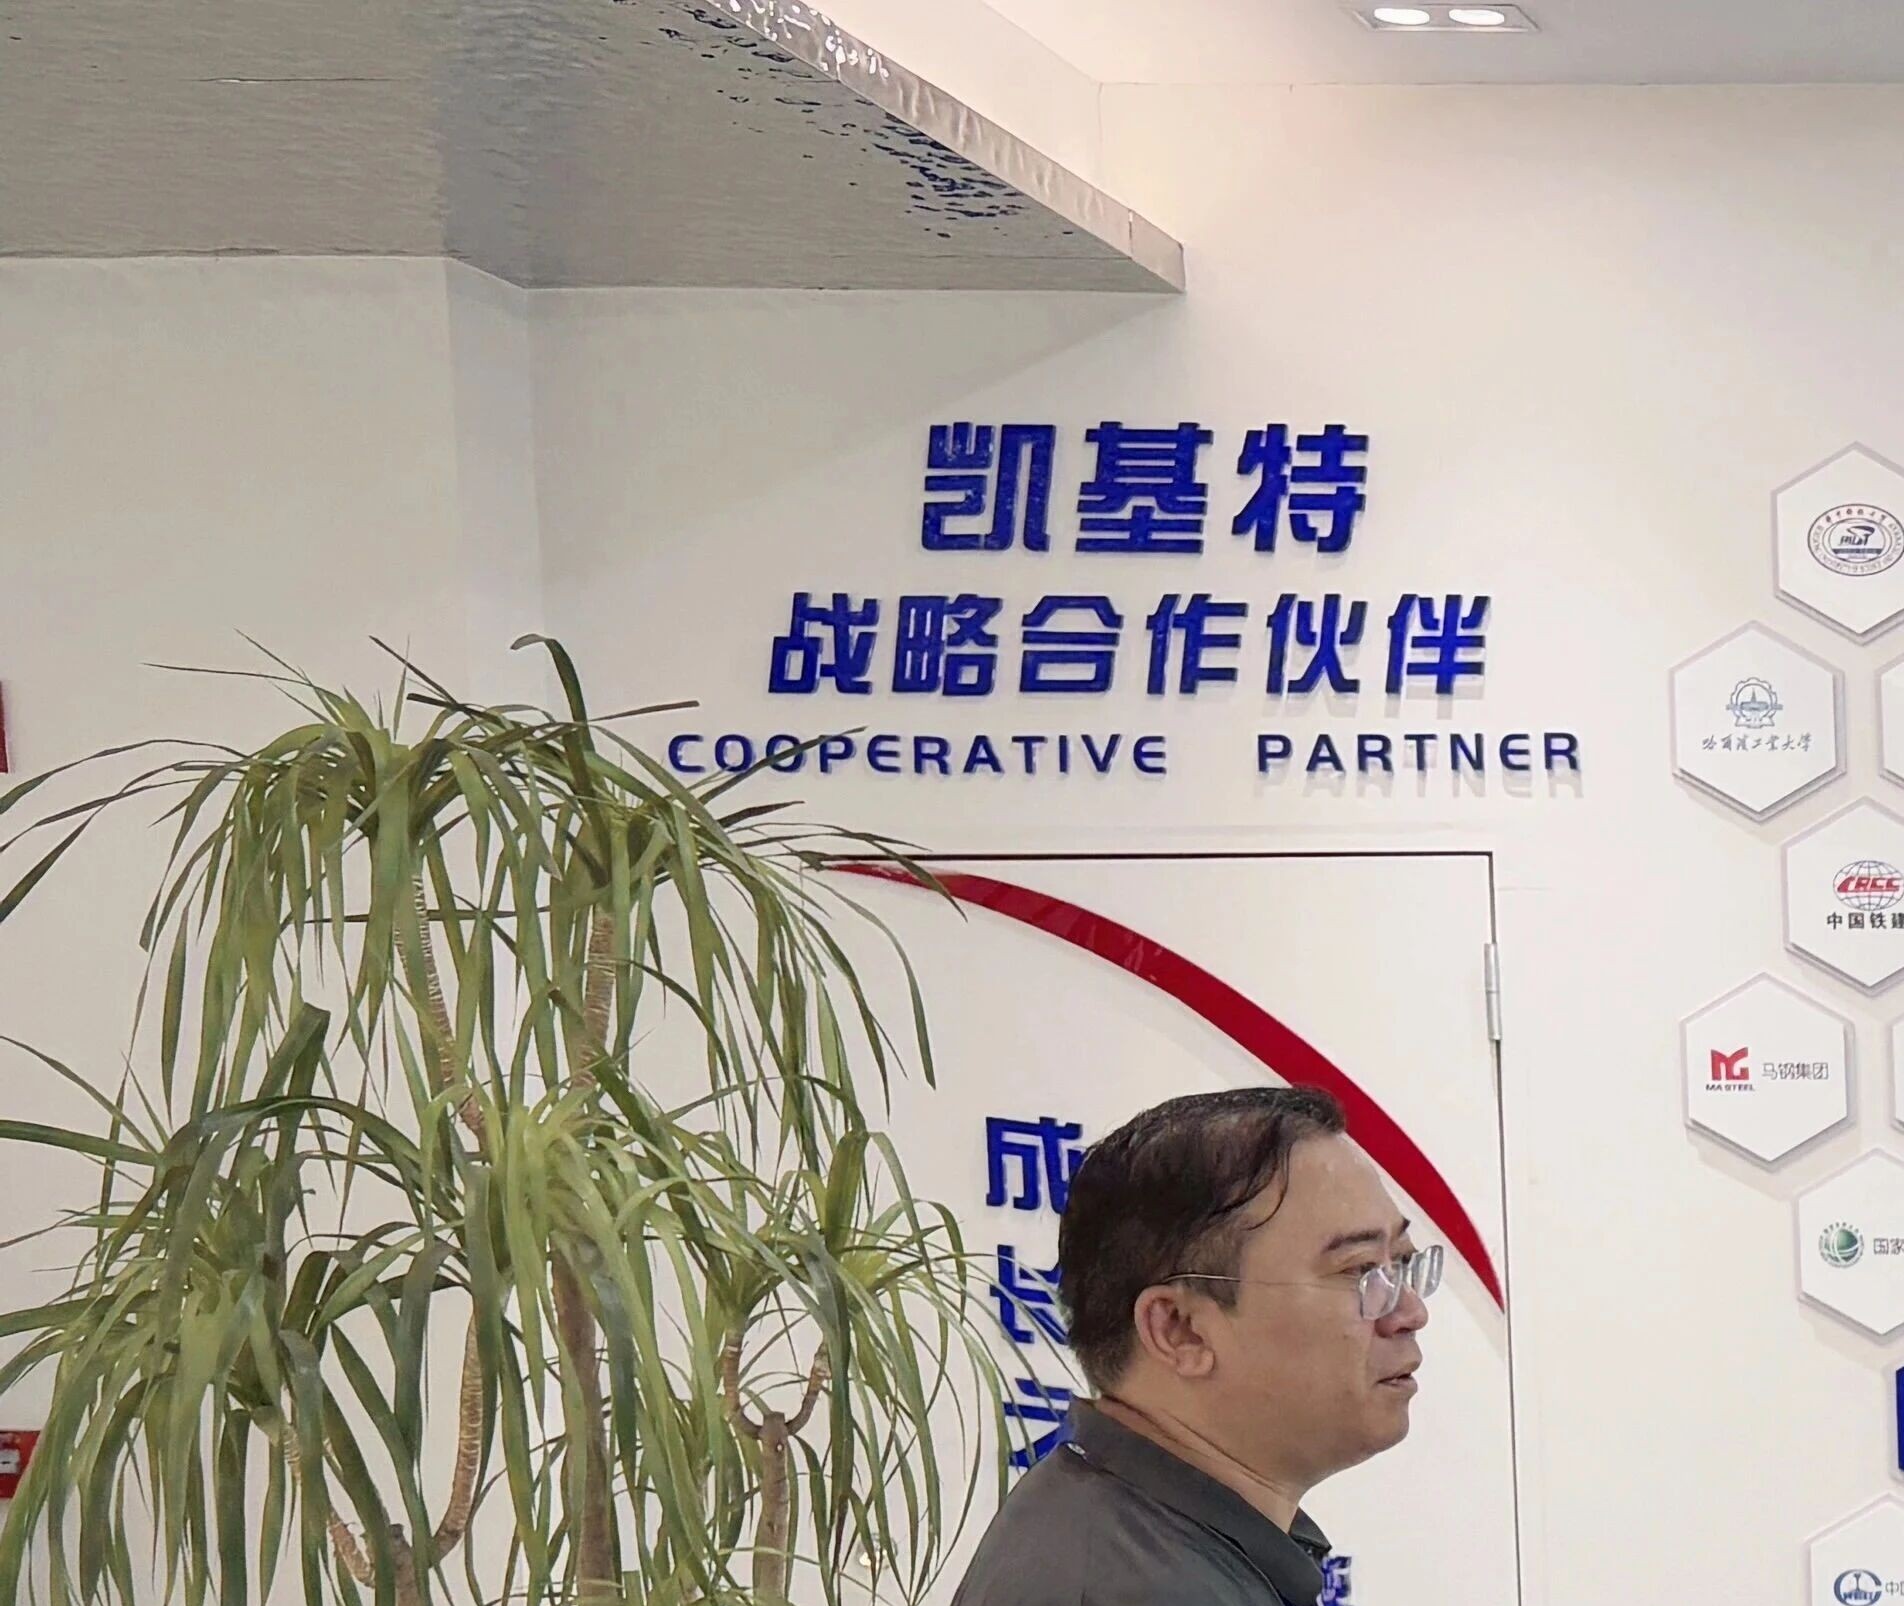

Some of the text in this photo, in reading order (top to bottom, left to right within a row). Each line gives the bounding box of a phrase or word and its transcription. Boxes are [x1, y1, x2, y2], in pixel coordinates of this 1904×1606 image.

[920, 421, 1369, 555] 凯基特
[767, 592, 1490, 697] 战略合作伙伴
[668, 731, 1580, 775] COOPERATIVE PARTNER
[1761, 1061, 1829, 1081] 马钢集团
